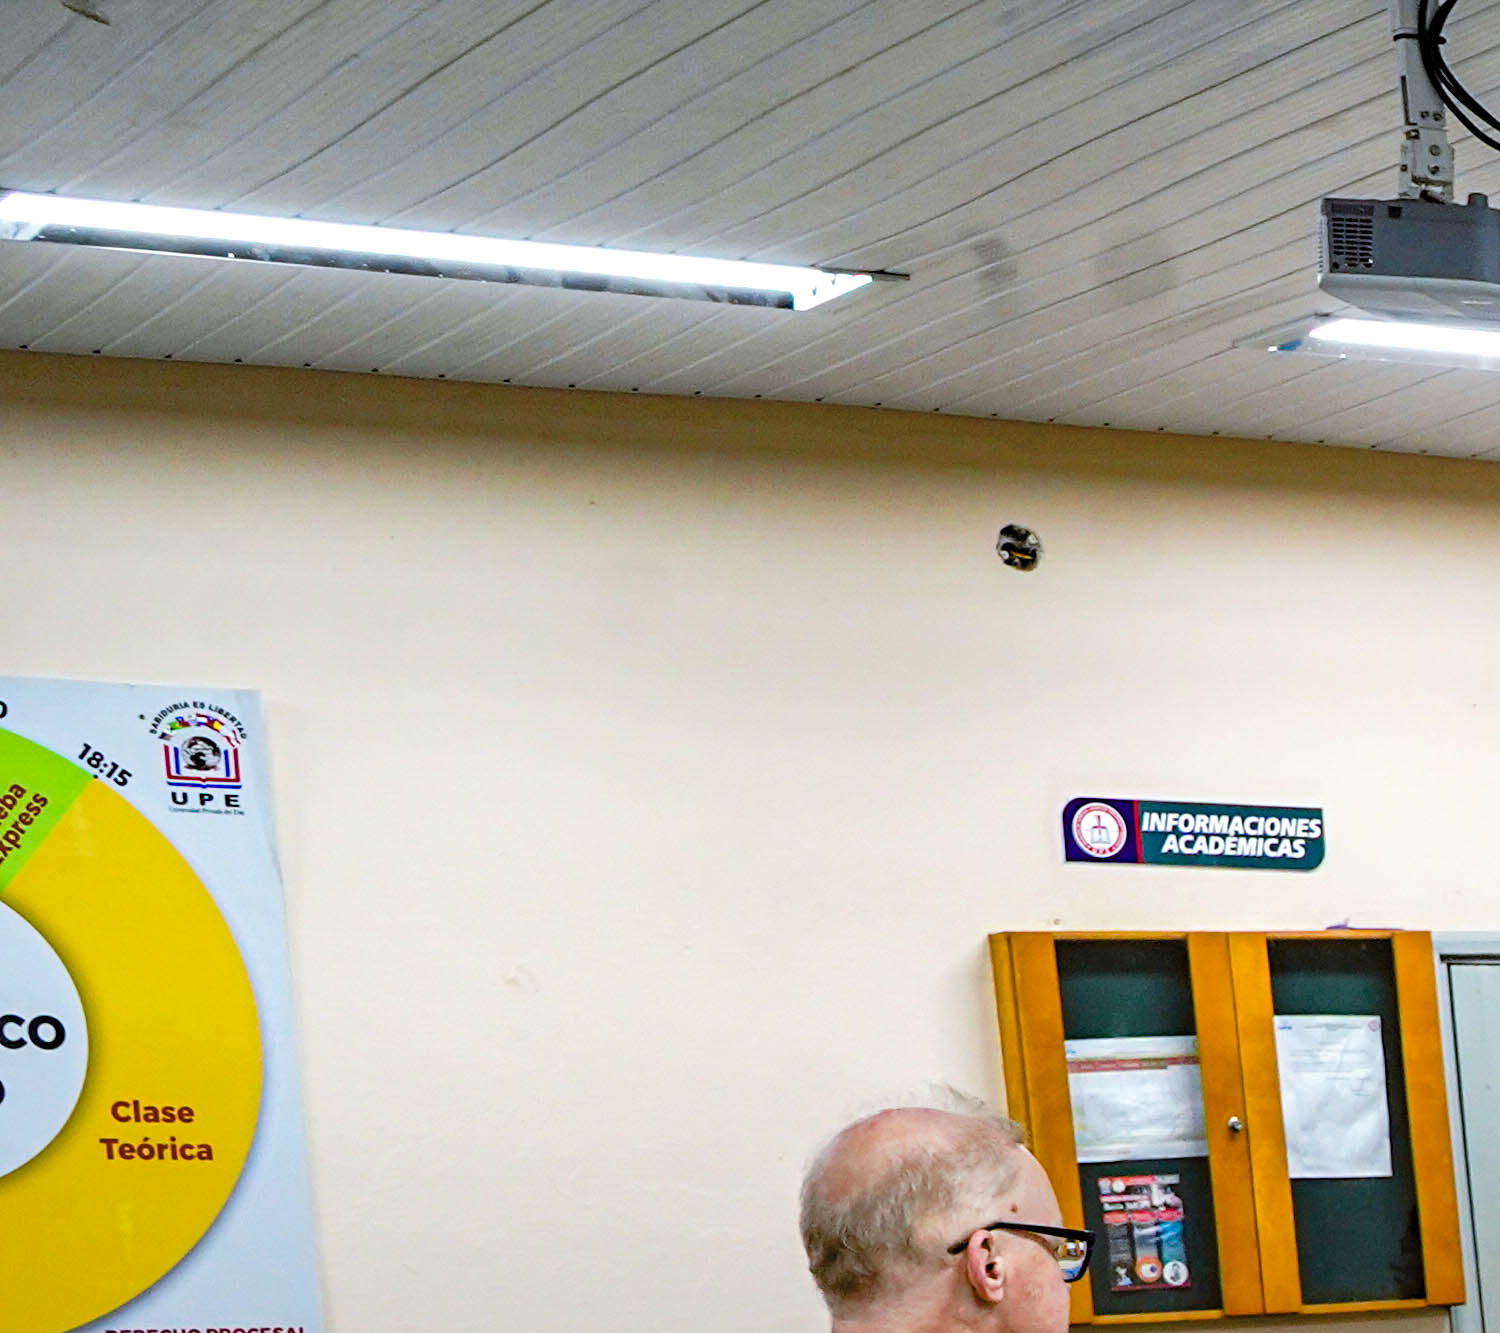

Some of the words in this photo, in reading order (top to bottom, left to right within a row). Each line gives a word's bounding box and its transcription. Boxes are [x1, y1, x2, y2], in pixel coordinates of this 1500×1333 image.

[78, 743, 133, 787] 18:15
[0, 793, 48, 865] xpress
[1141, 812, 1322, 838] INFORMACIONES
[1161, 833, 1306, 859] ACADÉMICAS
[111, 1100, 194, 1123] Clase
[99, 1136, 213, 1160] Teórica
